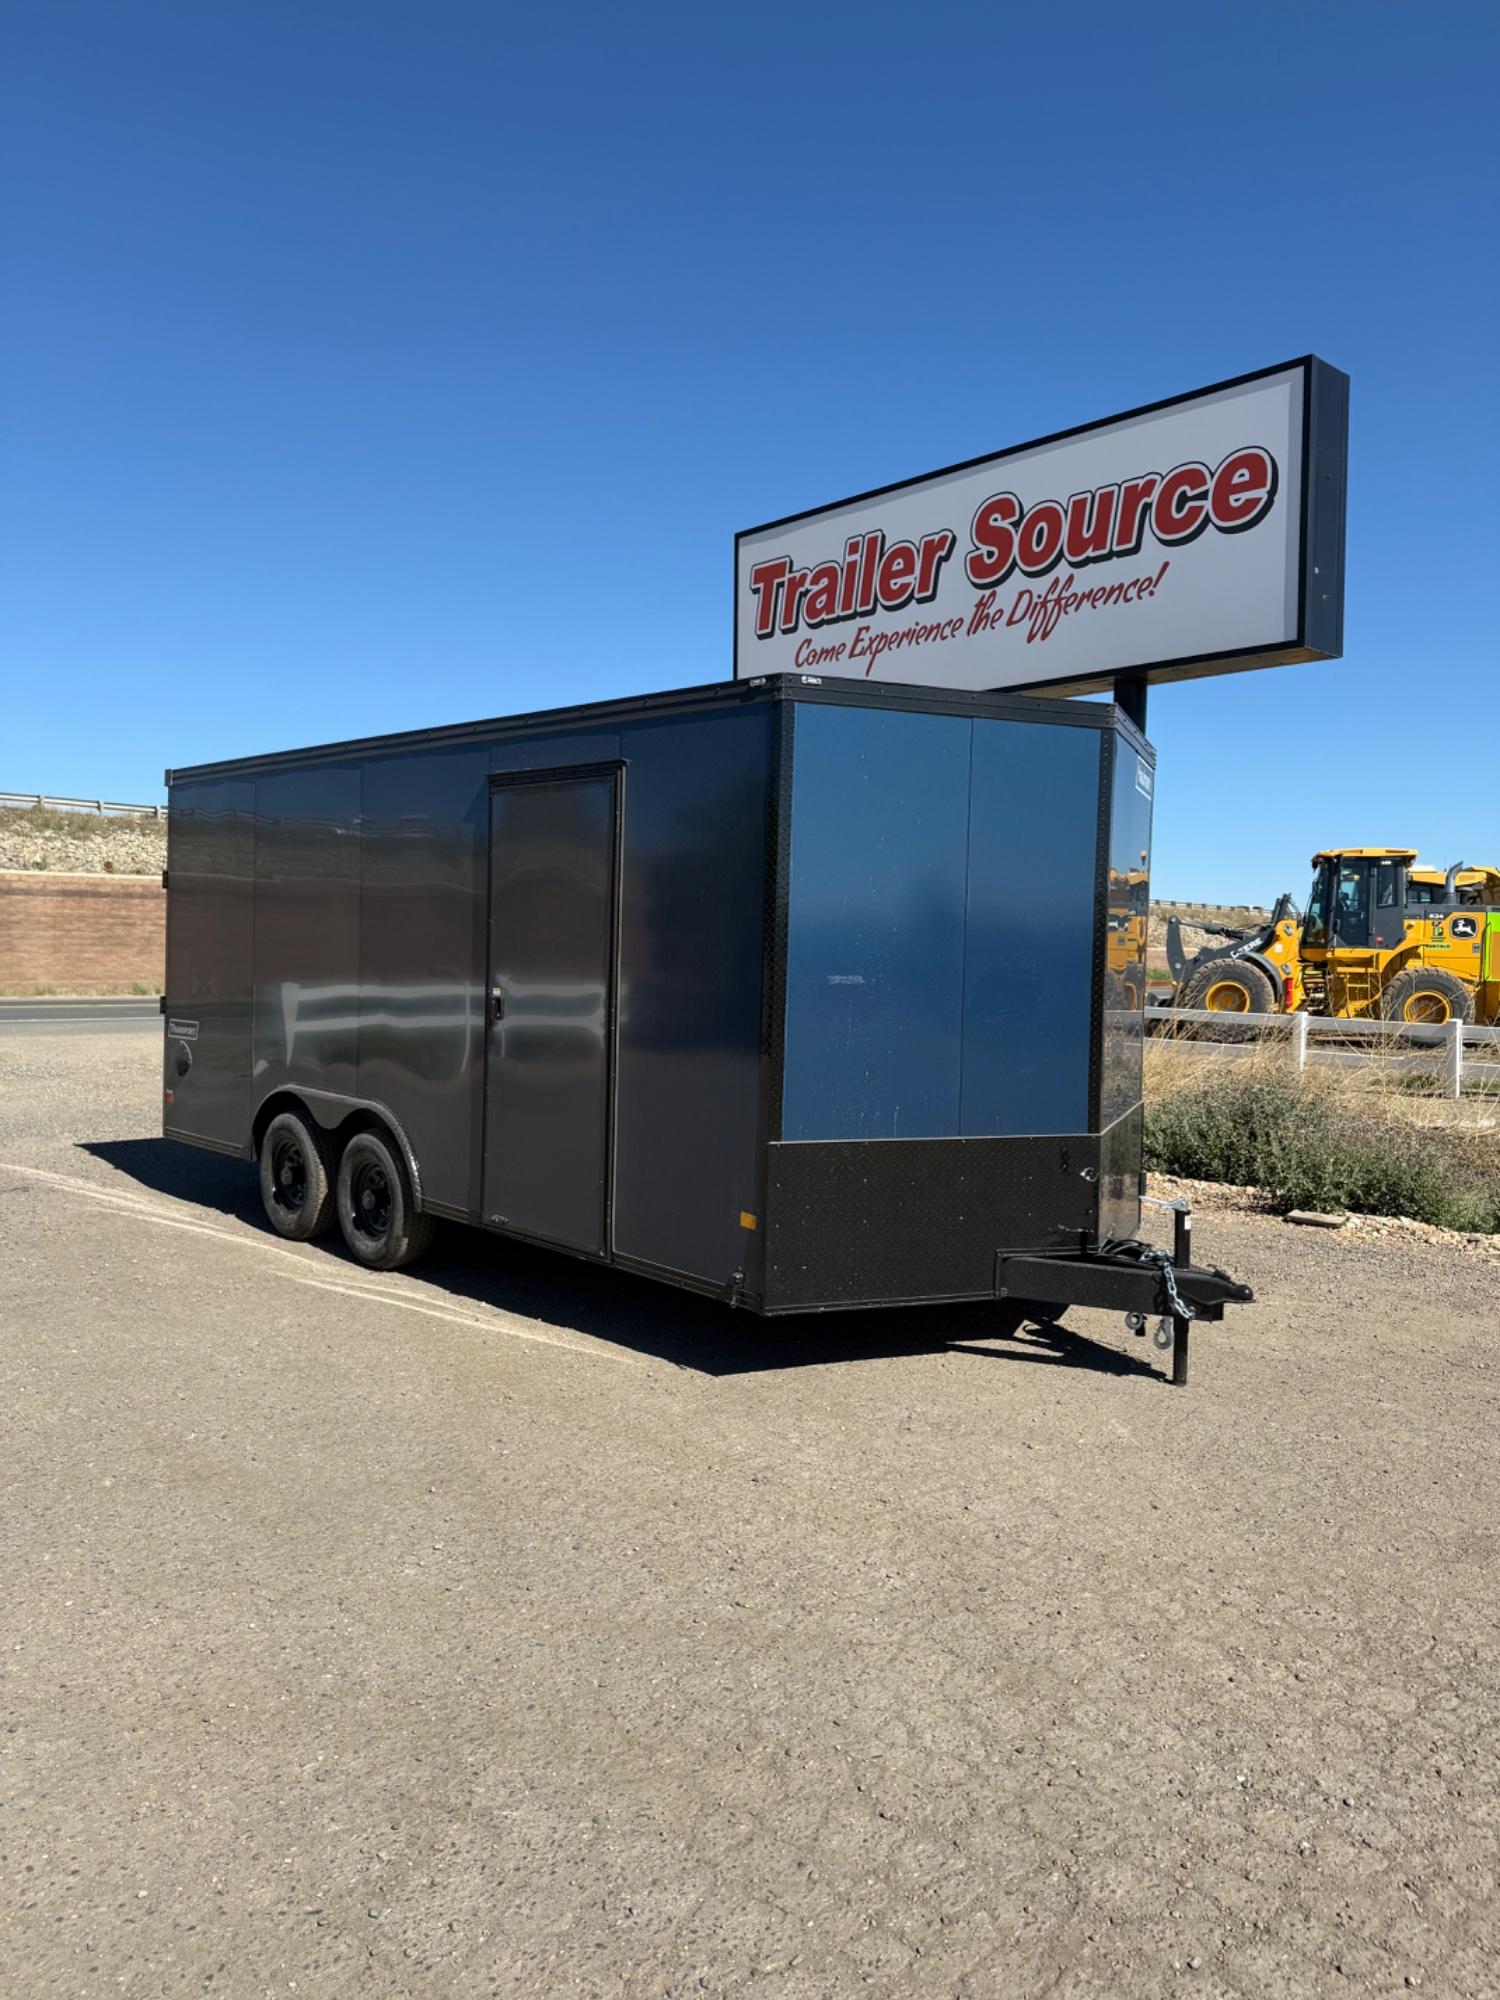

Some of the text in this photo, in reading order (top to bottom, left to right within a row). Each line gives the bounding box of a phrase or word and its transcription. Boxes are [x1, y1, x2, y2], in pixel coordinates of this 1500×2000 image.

[751, 446, 1278, 640] Trailer Source
[794, 561, 1170, 677] Come Experience the Difference!
